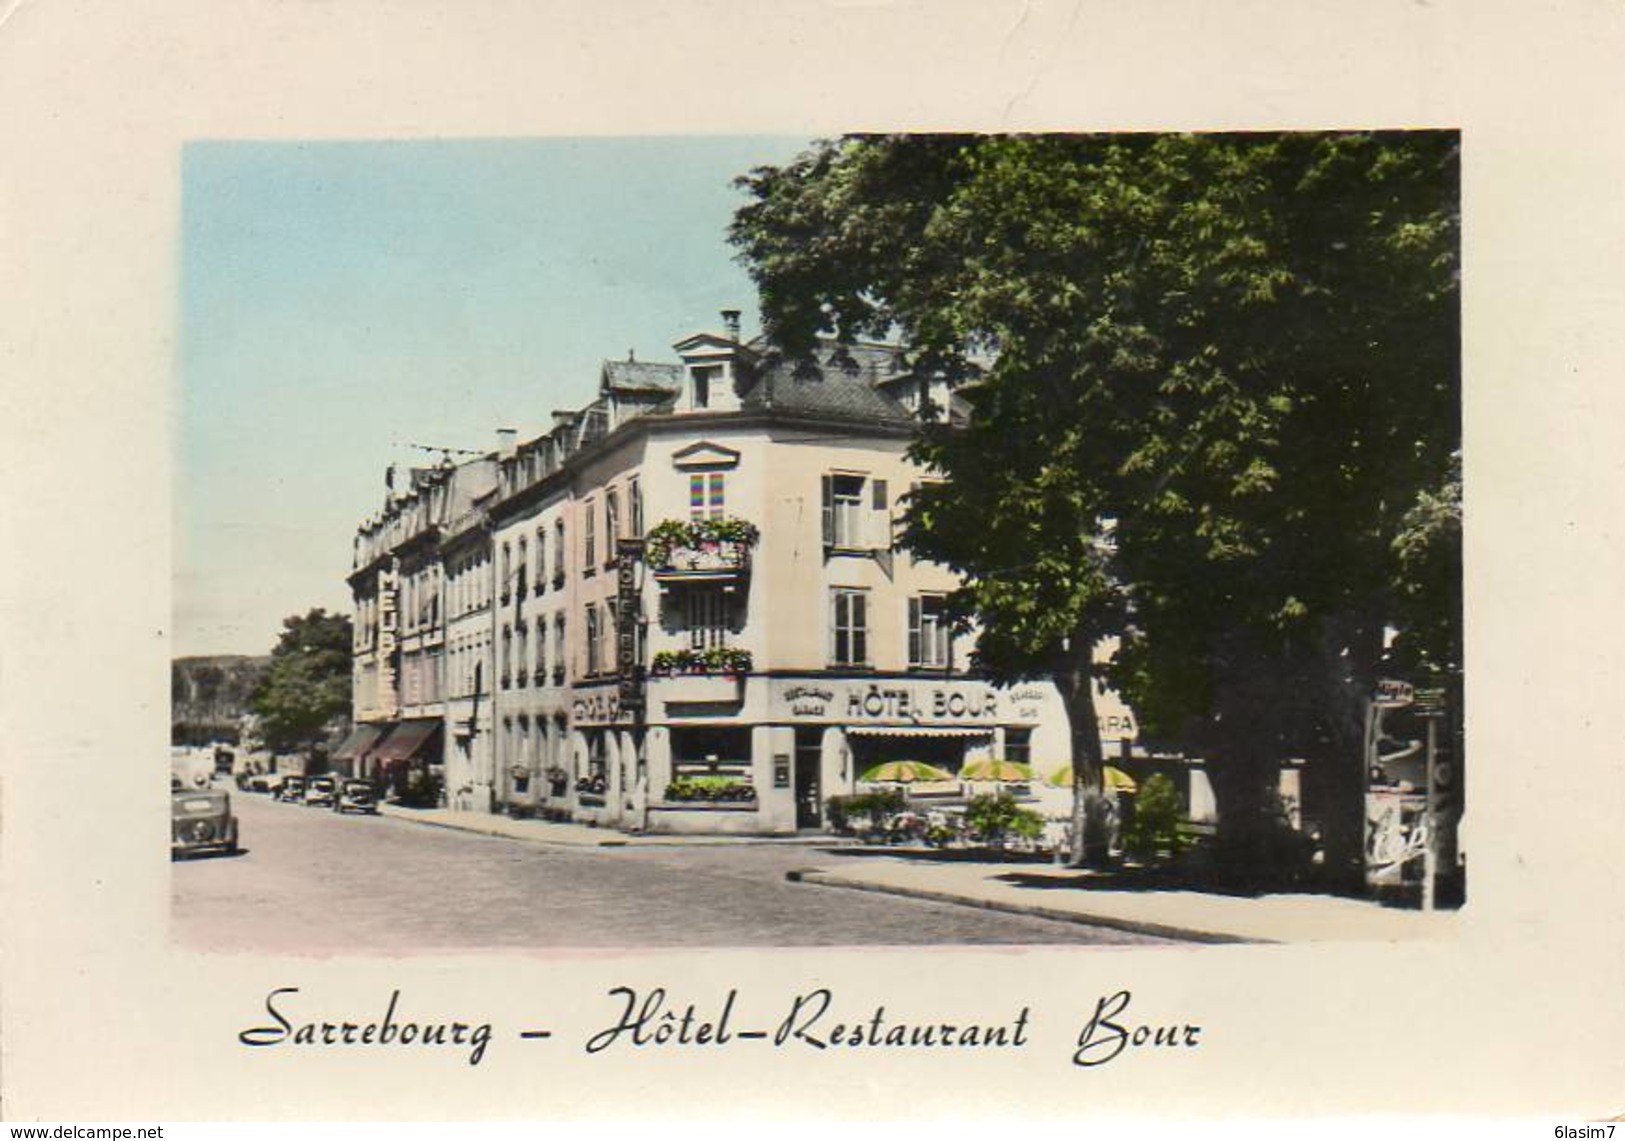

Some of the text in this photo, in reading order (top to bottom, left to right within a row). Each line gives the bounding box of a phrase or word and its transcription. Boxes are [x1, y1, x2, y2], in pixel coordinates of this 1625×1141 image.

[619, 554, 634, 623] HOTE
[377, 569, 398, 709] MEUBE
[846, 683, 923, 718] HÔTEL
[932, 688, 998, 718] BOUR
